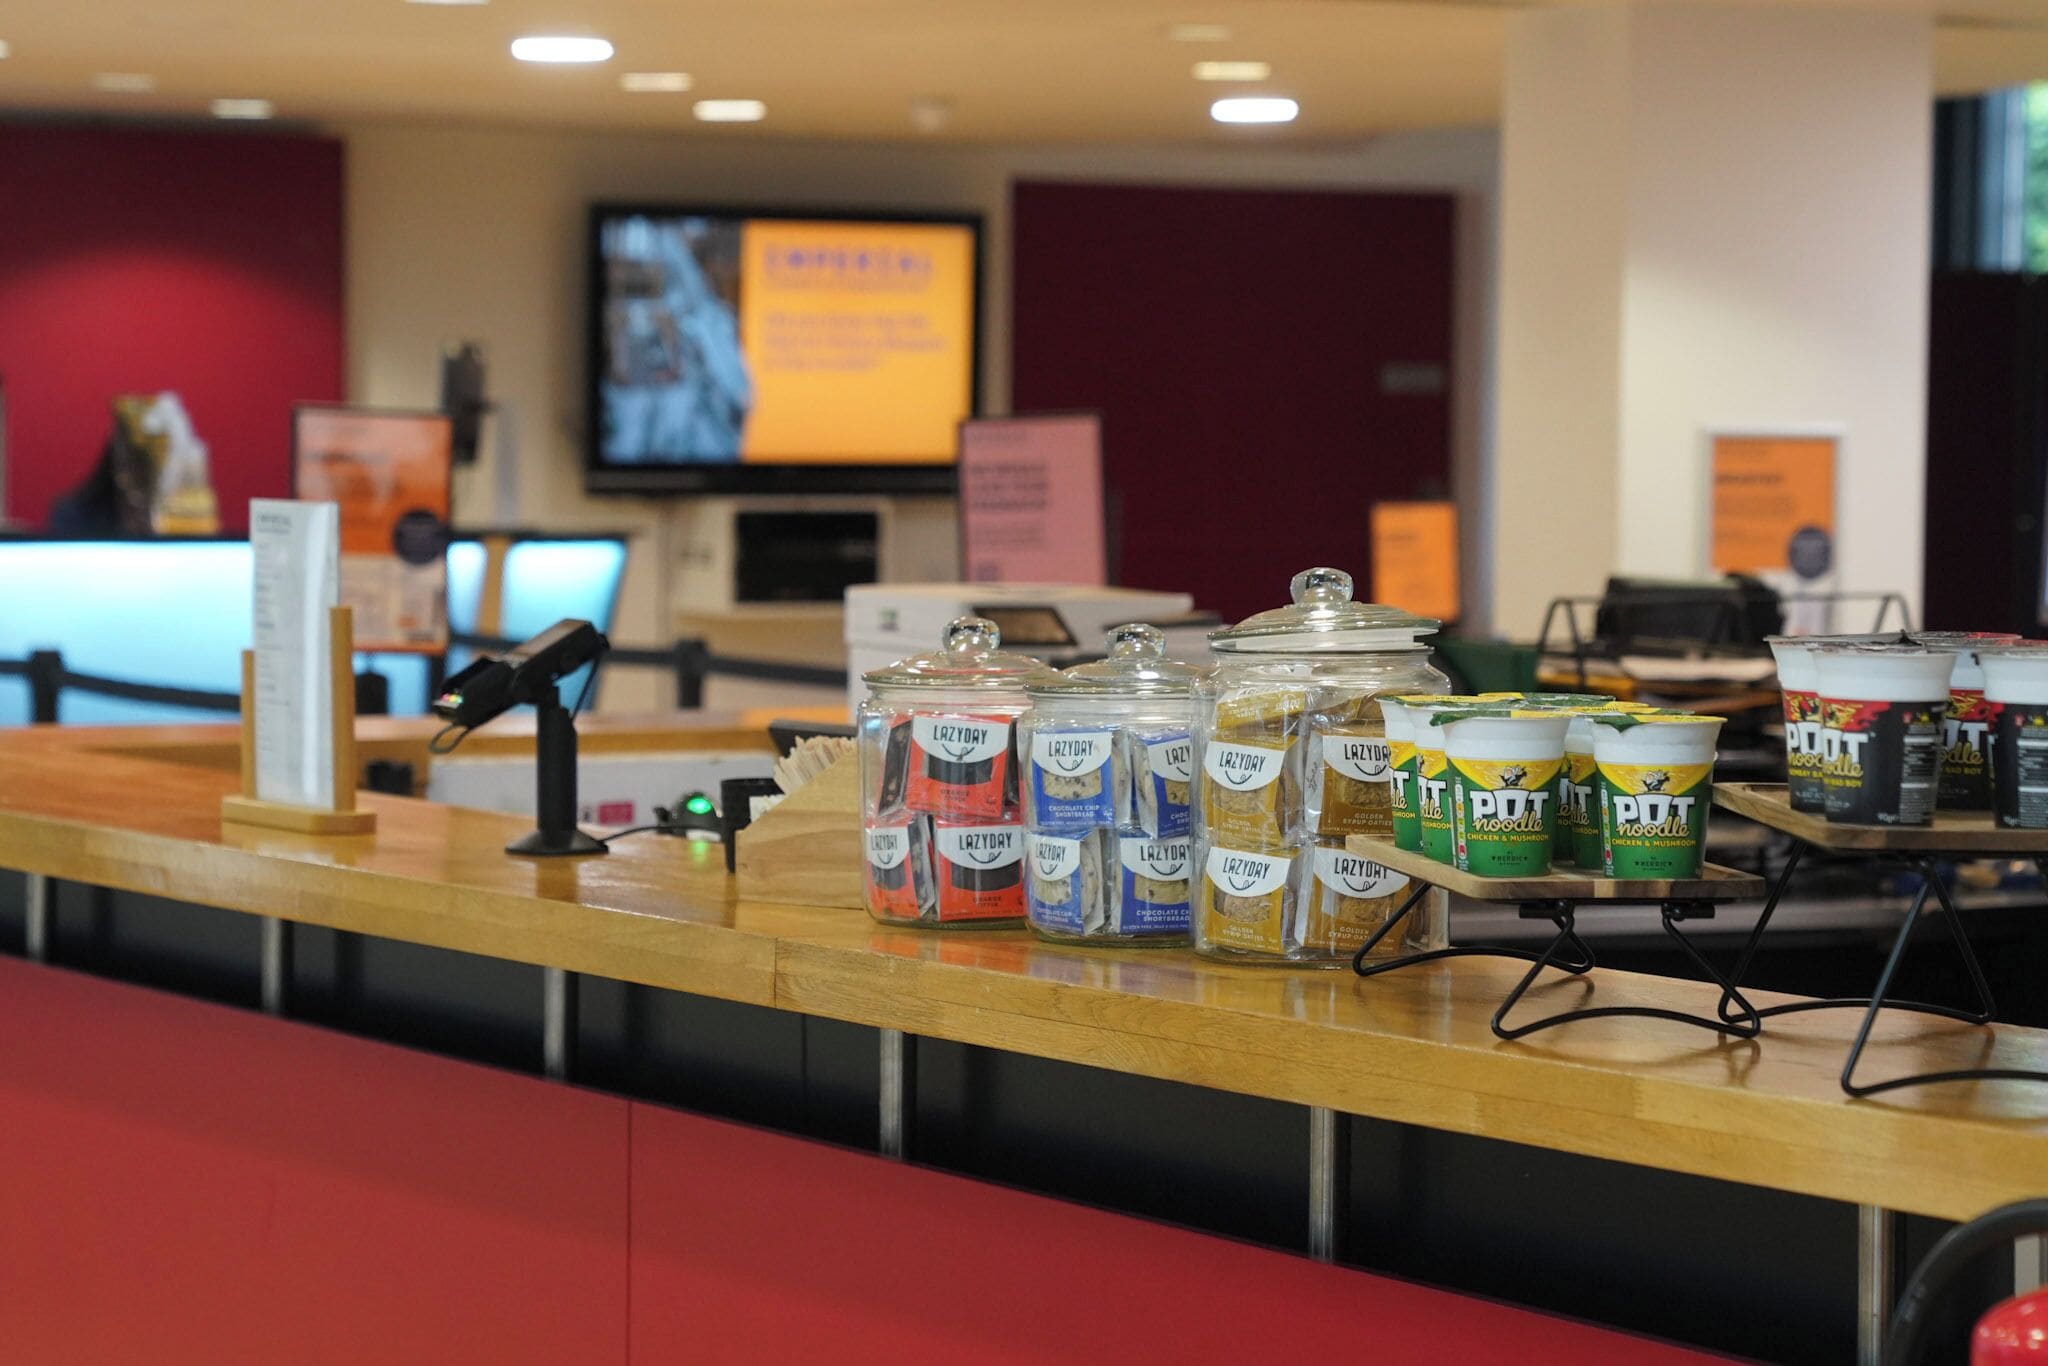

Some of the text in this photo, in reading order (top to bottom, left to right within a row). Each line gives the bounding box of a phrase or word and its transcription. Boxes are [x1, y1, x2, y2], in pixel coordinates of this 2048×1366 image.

[933, 725, 988, 745] LAZYDAY
[1784, 721, 1823, 755] PO
[1048, 740, 1095, 757] LAZYDAY
[1165, 745, 1191, 765] LAZY
[1344, 743, 1390, 761] LAZYDA
[1822, 727, 1869, 764] OT
[1219, 750, 1266, 773] LAZYDAY
[1469, 789, 1550, 822] POT
[1613, 793, 1696, 827] POT
[1354, 812, 1384, 820] GOLDEN
[1472, 810, 1544, 832] noodle
[1616, 815, 1690, 838] noodle
[871, 834, 898, 851] LAZYDAY
[959, 832, 1012, 851] LAZYDAY
[1467, 832, 1499, 841] CHICKEN
[1510, 833, 1549, 842] MUSHROOM
[1611, 838, 1643, 846] CHICKEN
[1653, 839, 1697, 847] MUSHROOM
[1035, 842, 1067, 863] LAZYDAY
[1222, 856, 1271, 880] LAZYDAY
[1340, 926, 1370, 935] GOLDEN
